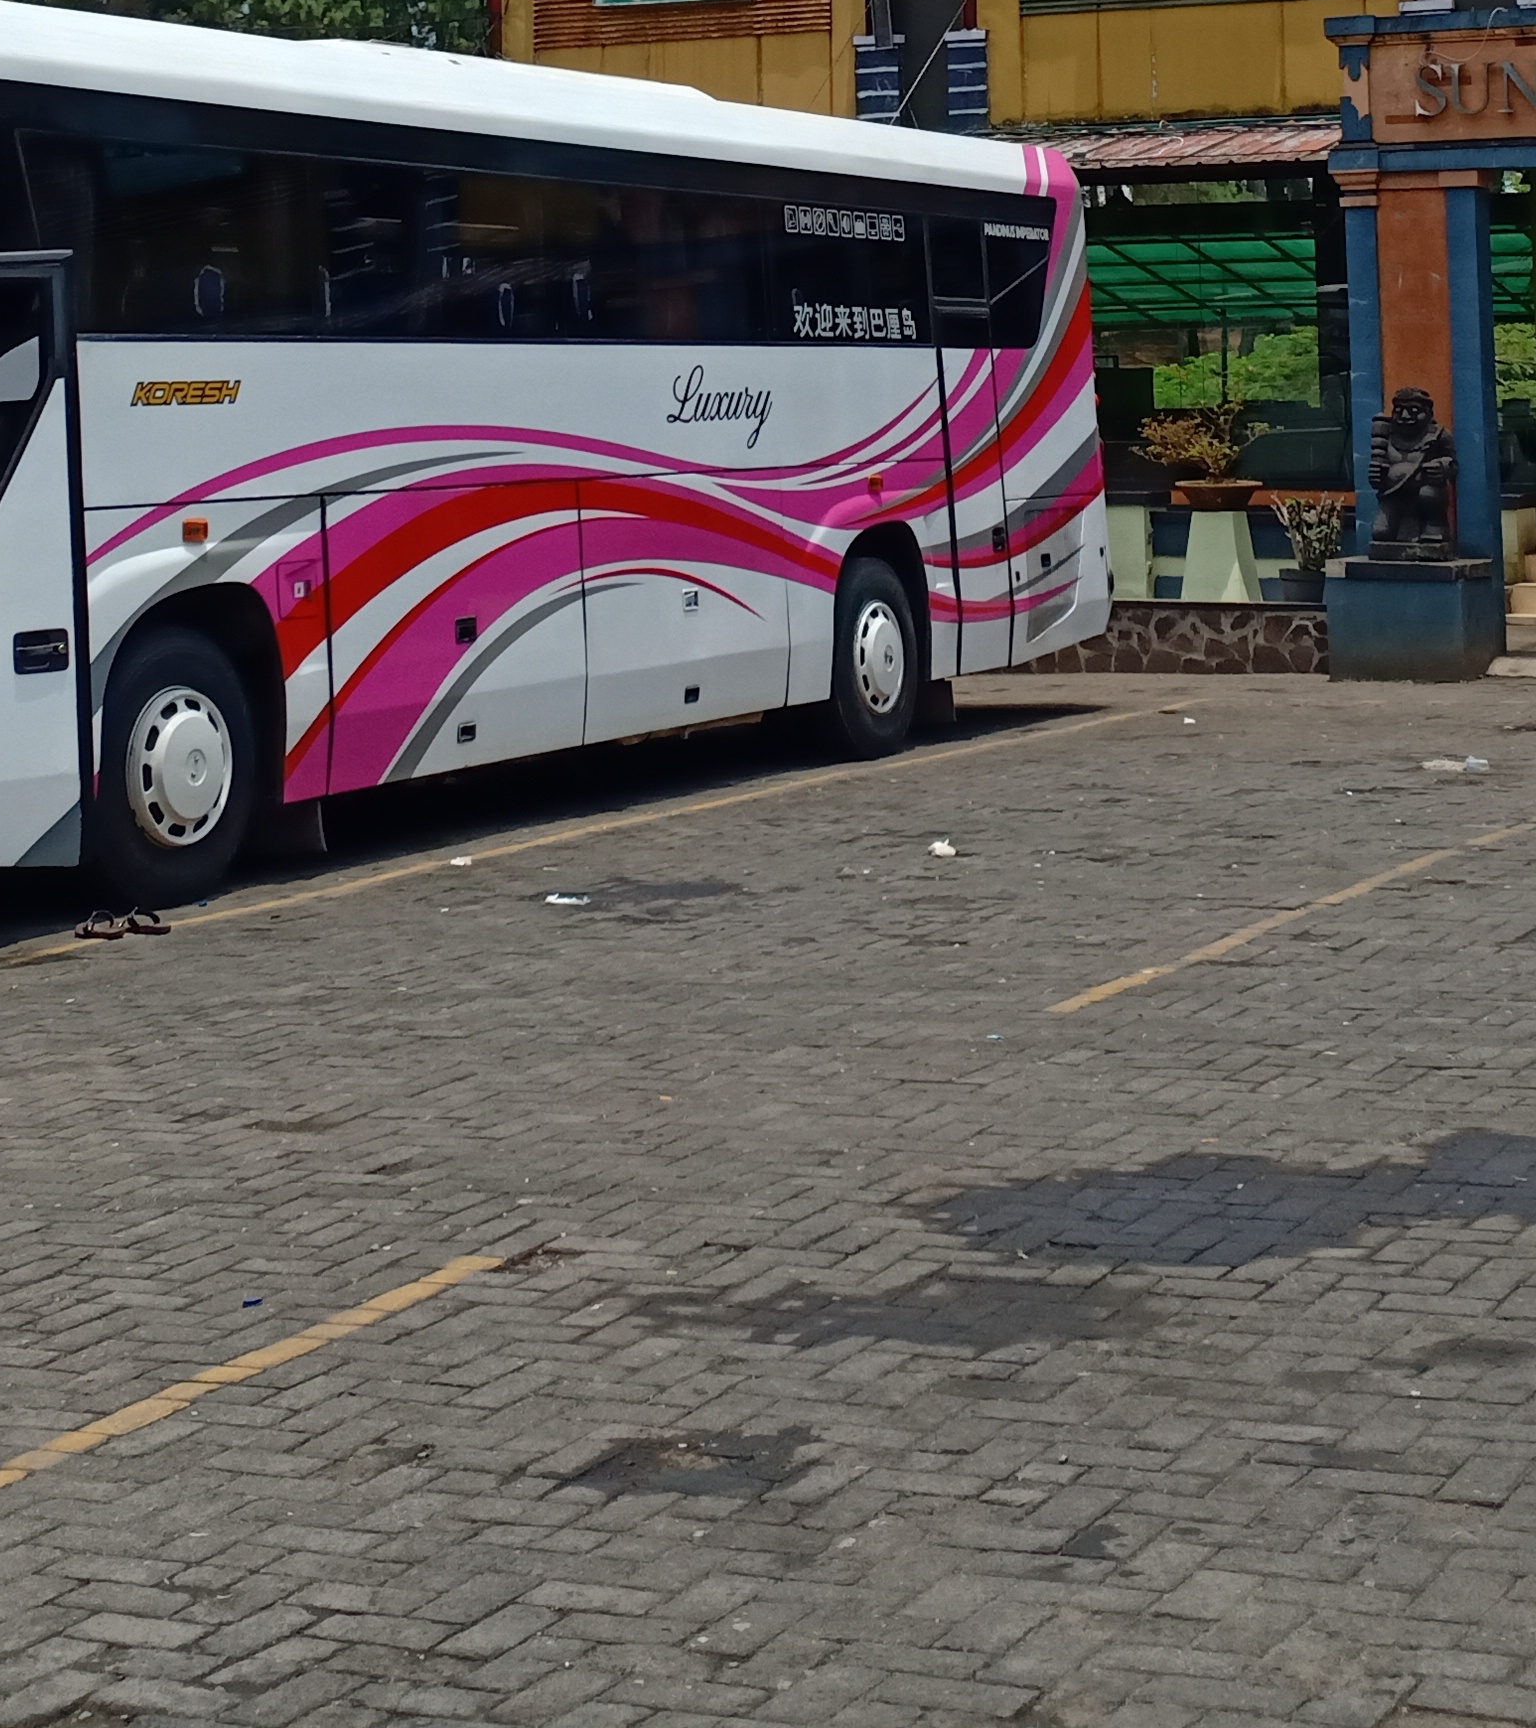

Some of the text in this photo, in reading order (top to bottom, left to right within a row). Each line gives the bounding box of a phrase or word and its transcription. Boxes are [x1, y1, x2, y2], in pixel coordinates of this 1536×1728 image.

[792, 302, 917, 340] 欢迎来到巴厘岛
[130, 380, 242, 407] KORESH
[666, 364, 773, 450] Luxury
